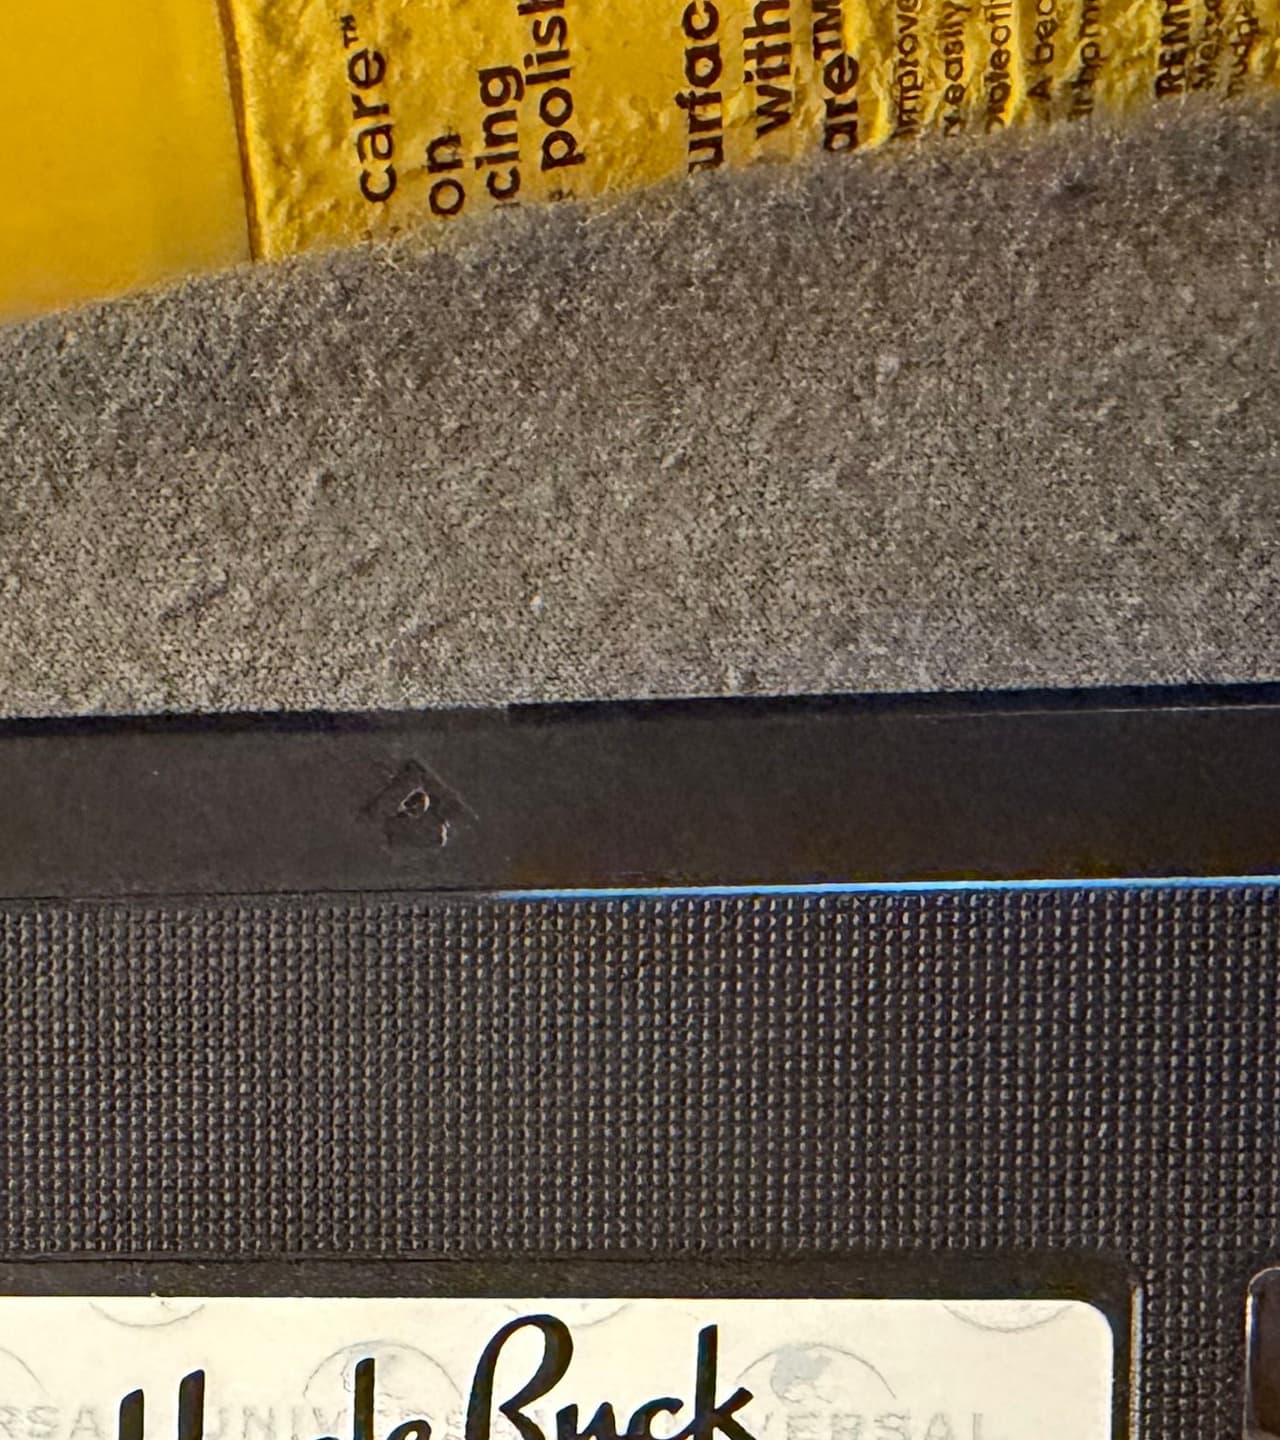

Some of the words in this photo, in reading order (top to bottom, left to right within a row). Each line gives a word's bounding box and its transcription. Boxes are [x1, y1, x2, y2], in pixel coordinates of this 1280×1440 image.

[475, 65, 525, 209] cing
[742, 0, 793, 140] with
[426, 134, 466, 216] on
